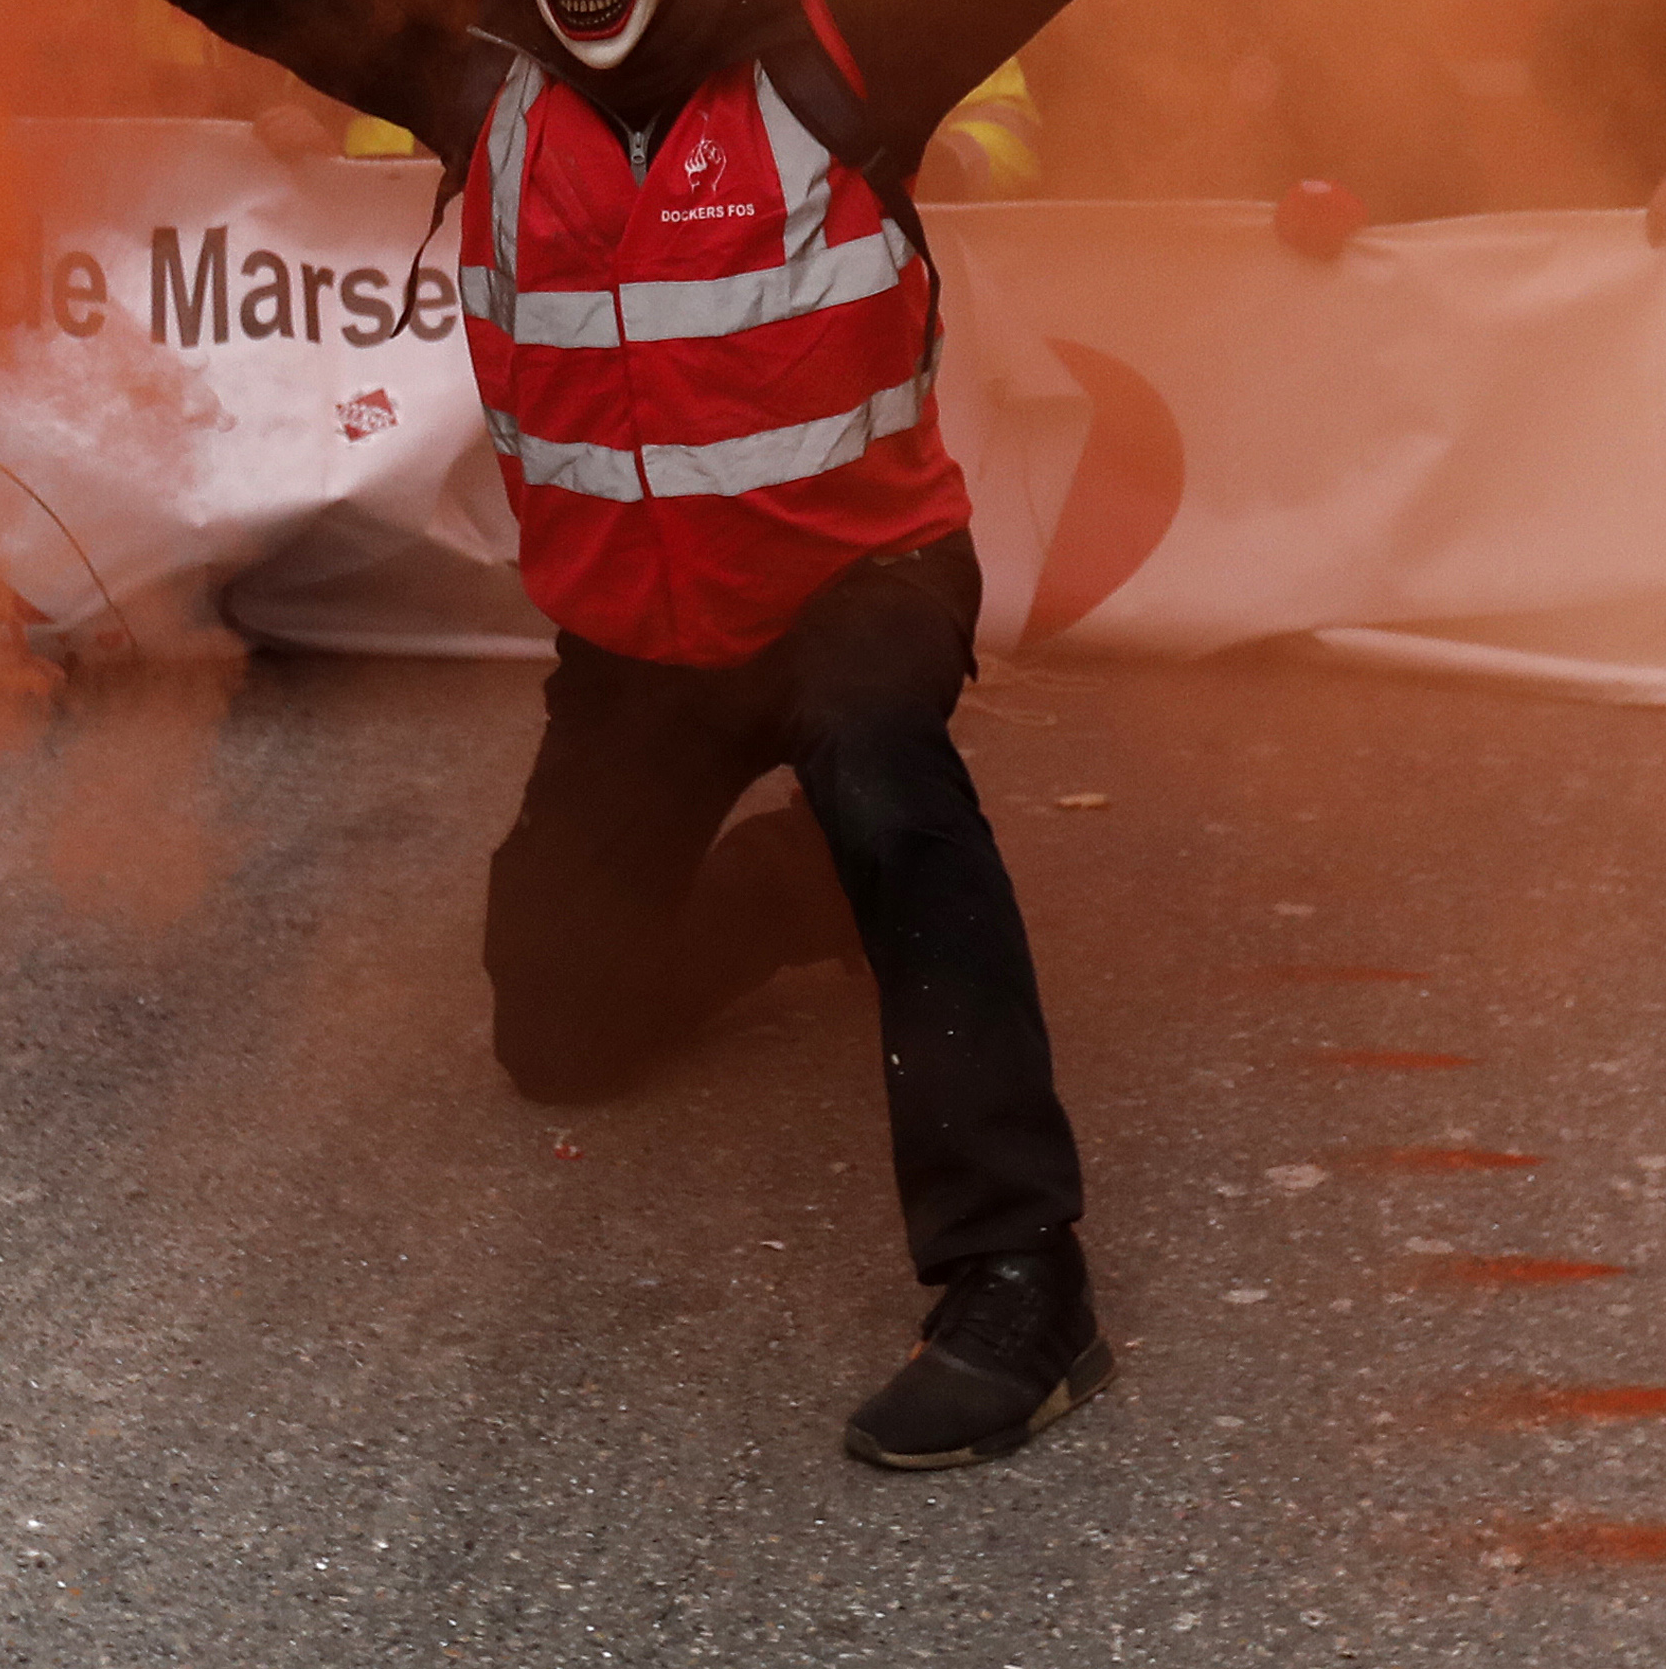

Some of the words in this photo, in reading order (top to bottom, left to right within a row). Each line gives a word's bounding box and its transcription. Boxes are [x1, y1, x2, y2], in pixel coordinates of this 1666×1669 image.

[661, 205, 725, 223] DOCKERS
[728, 203, 756, 217] FOS
[149, 224, 459, 349] Marse
